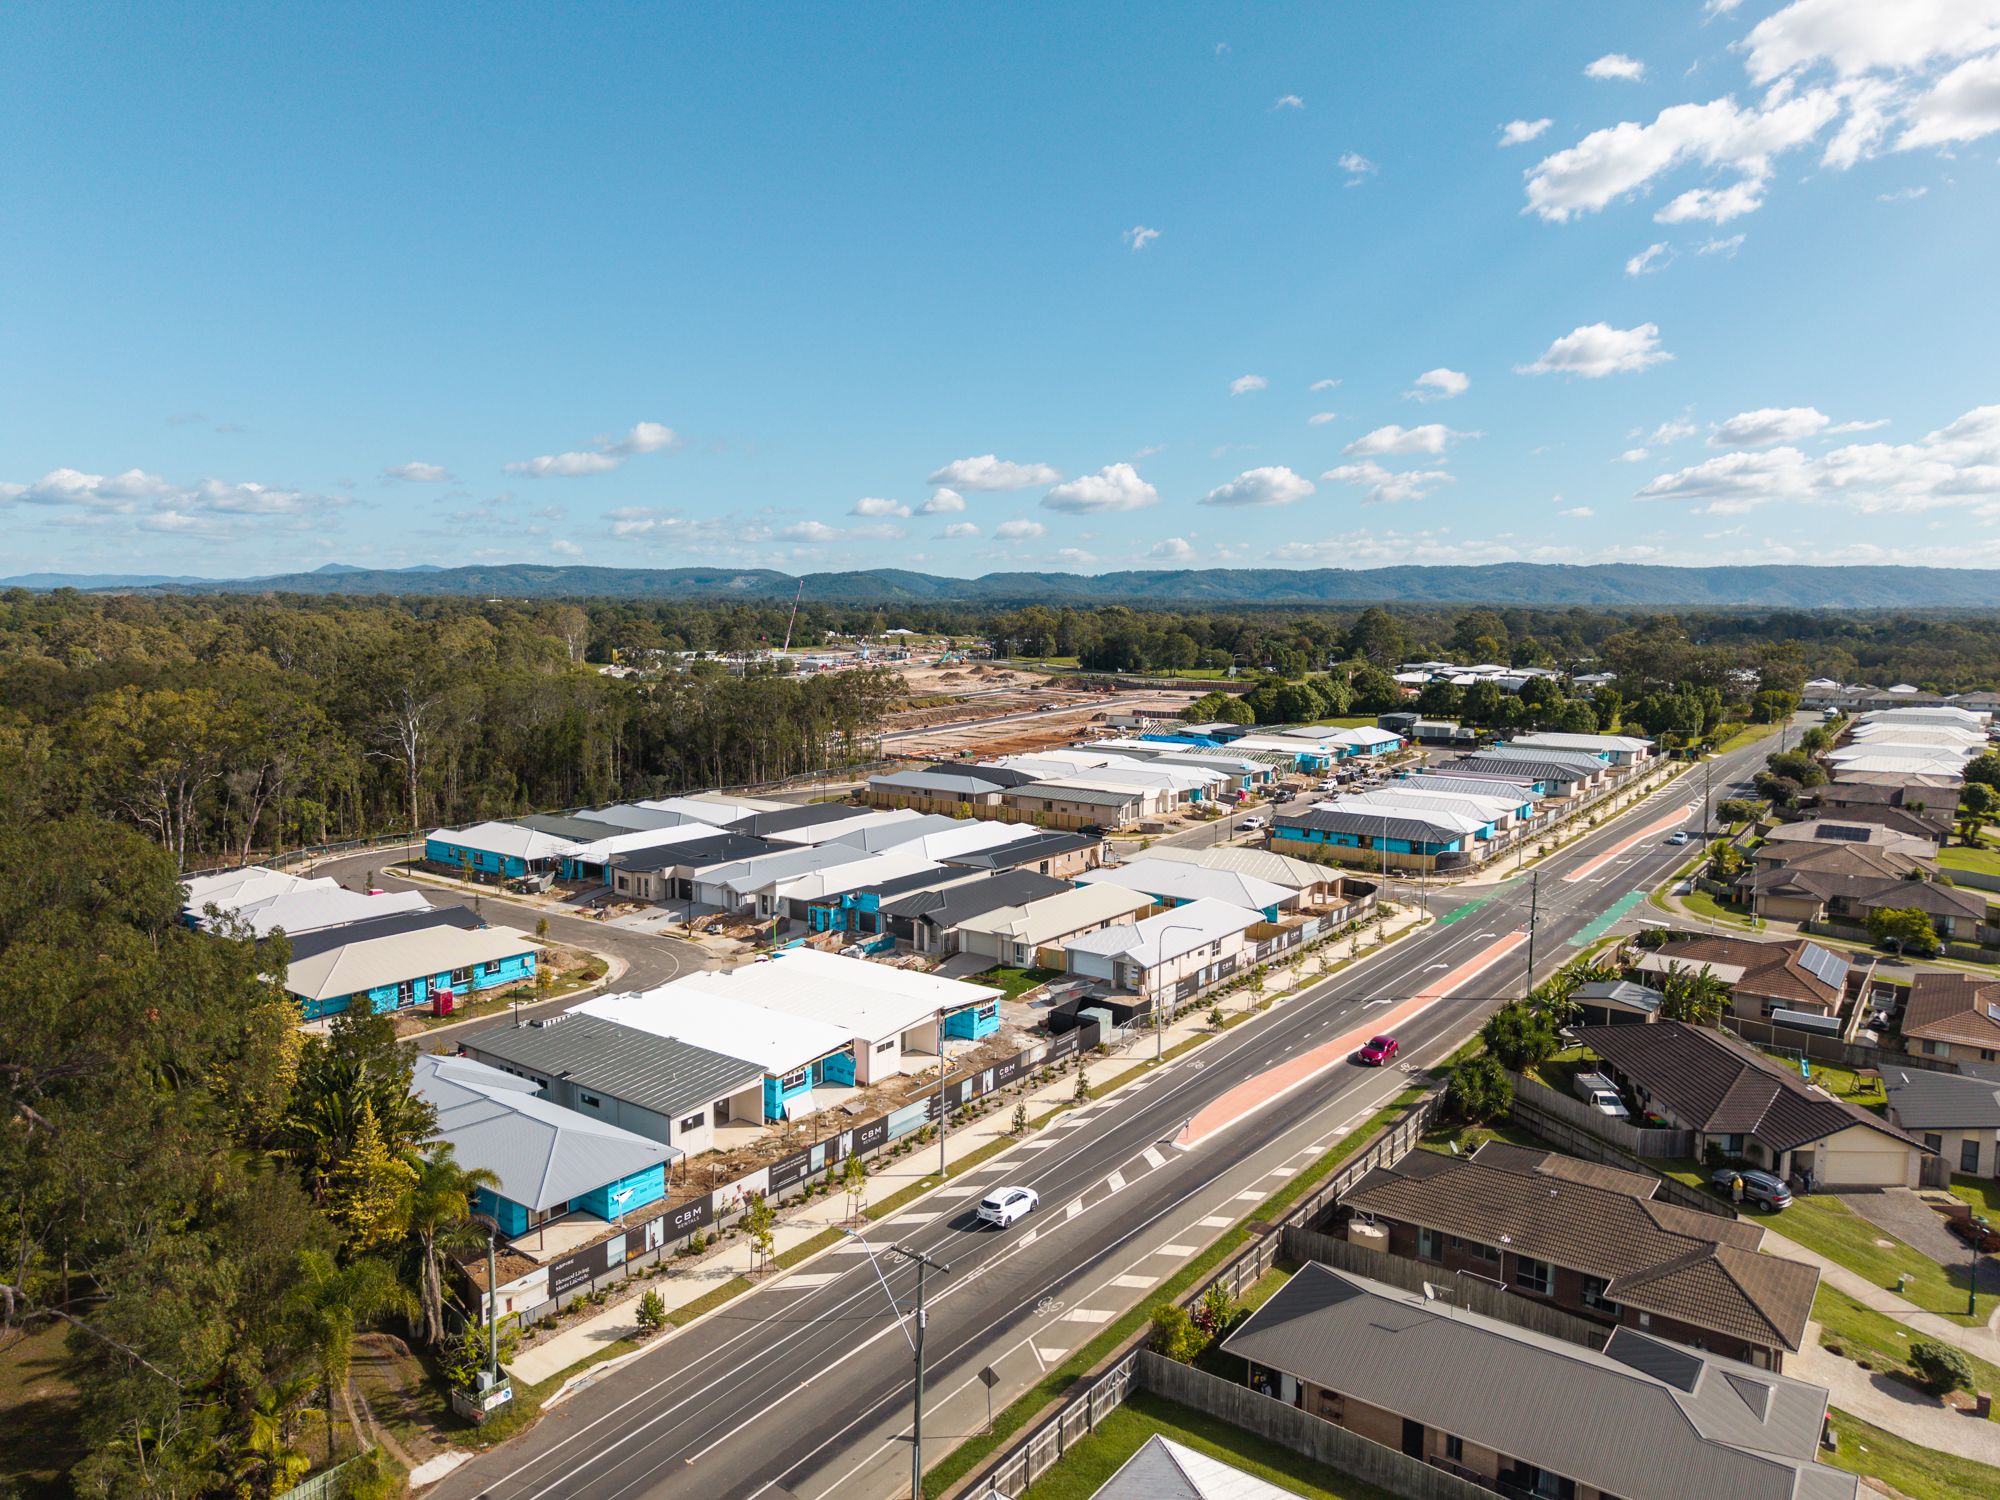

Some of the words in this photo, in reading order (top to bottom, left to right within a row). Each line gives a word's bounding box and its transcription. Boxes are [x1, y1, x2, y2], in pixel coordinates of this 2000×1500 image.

[999, 1063, 1015, 1076] CBM
[861, 1125, 882, 1141] CBM
[675, 1206, 702, 1224] CBM
[677, 1216, 700, 1229] RENTALS
